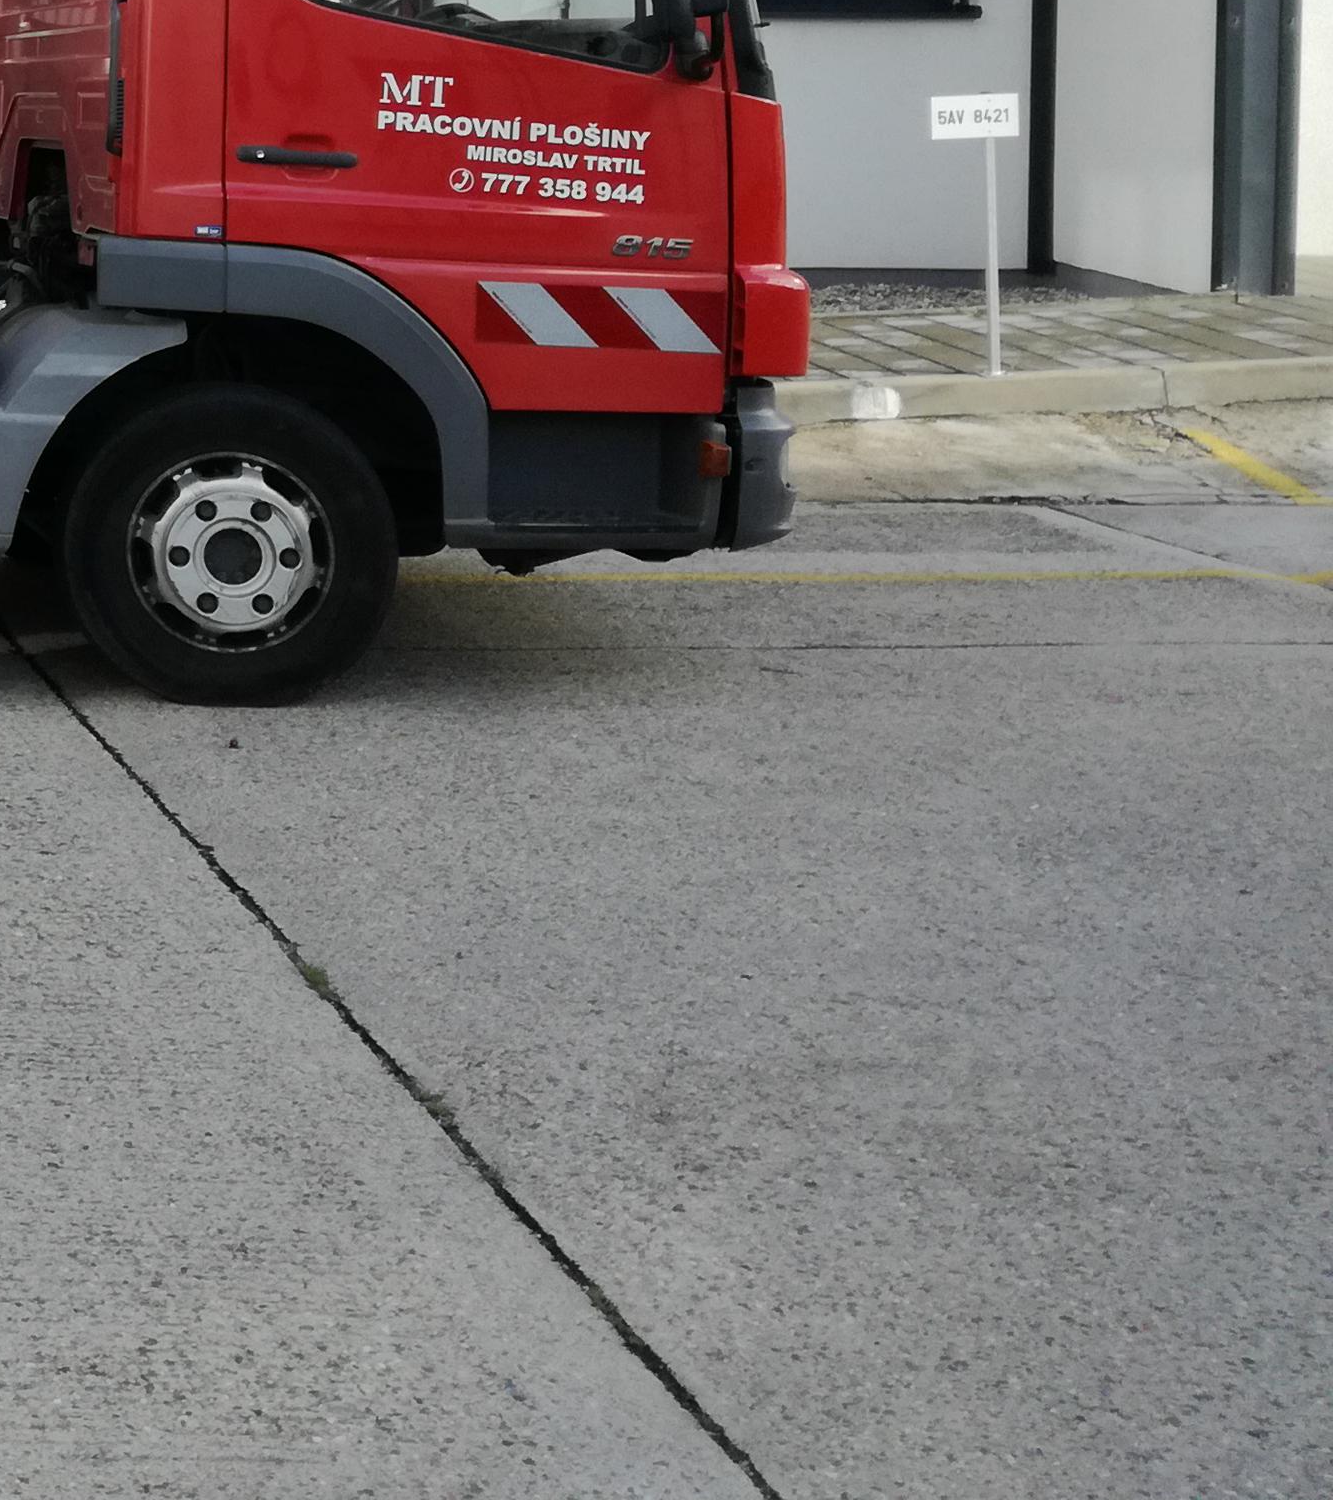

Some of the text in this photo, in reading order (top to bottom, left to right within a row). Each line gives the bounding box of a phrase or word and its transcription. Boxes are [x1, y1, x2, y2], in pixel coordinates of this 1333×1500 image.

[379, 72, 454, 108] MT
[377, 110, 652, 151] PRACOVNÍ PLOŠINY
[937, 108, 1010, 125] 5AV 8421
[466, 144, 646, 175] MIROSLAV TRTIL
[480, 171, 645, 205] 777 358 944
[612, 234, 695, 261] 815
